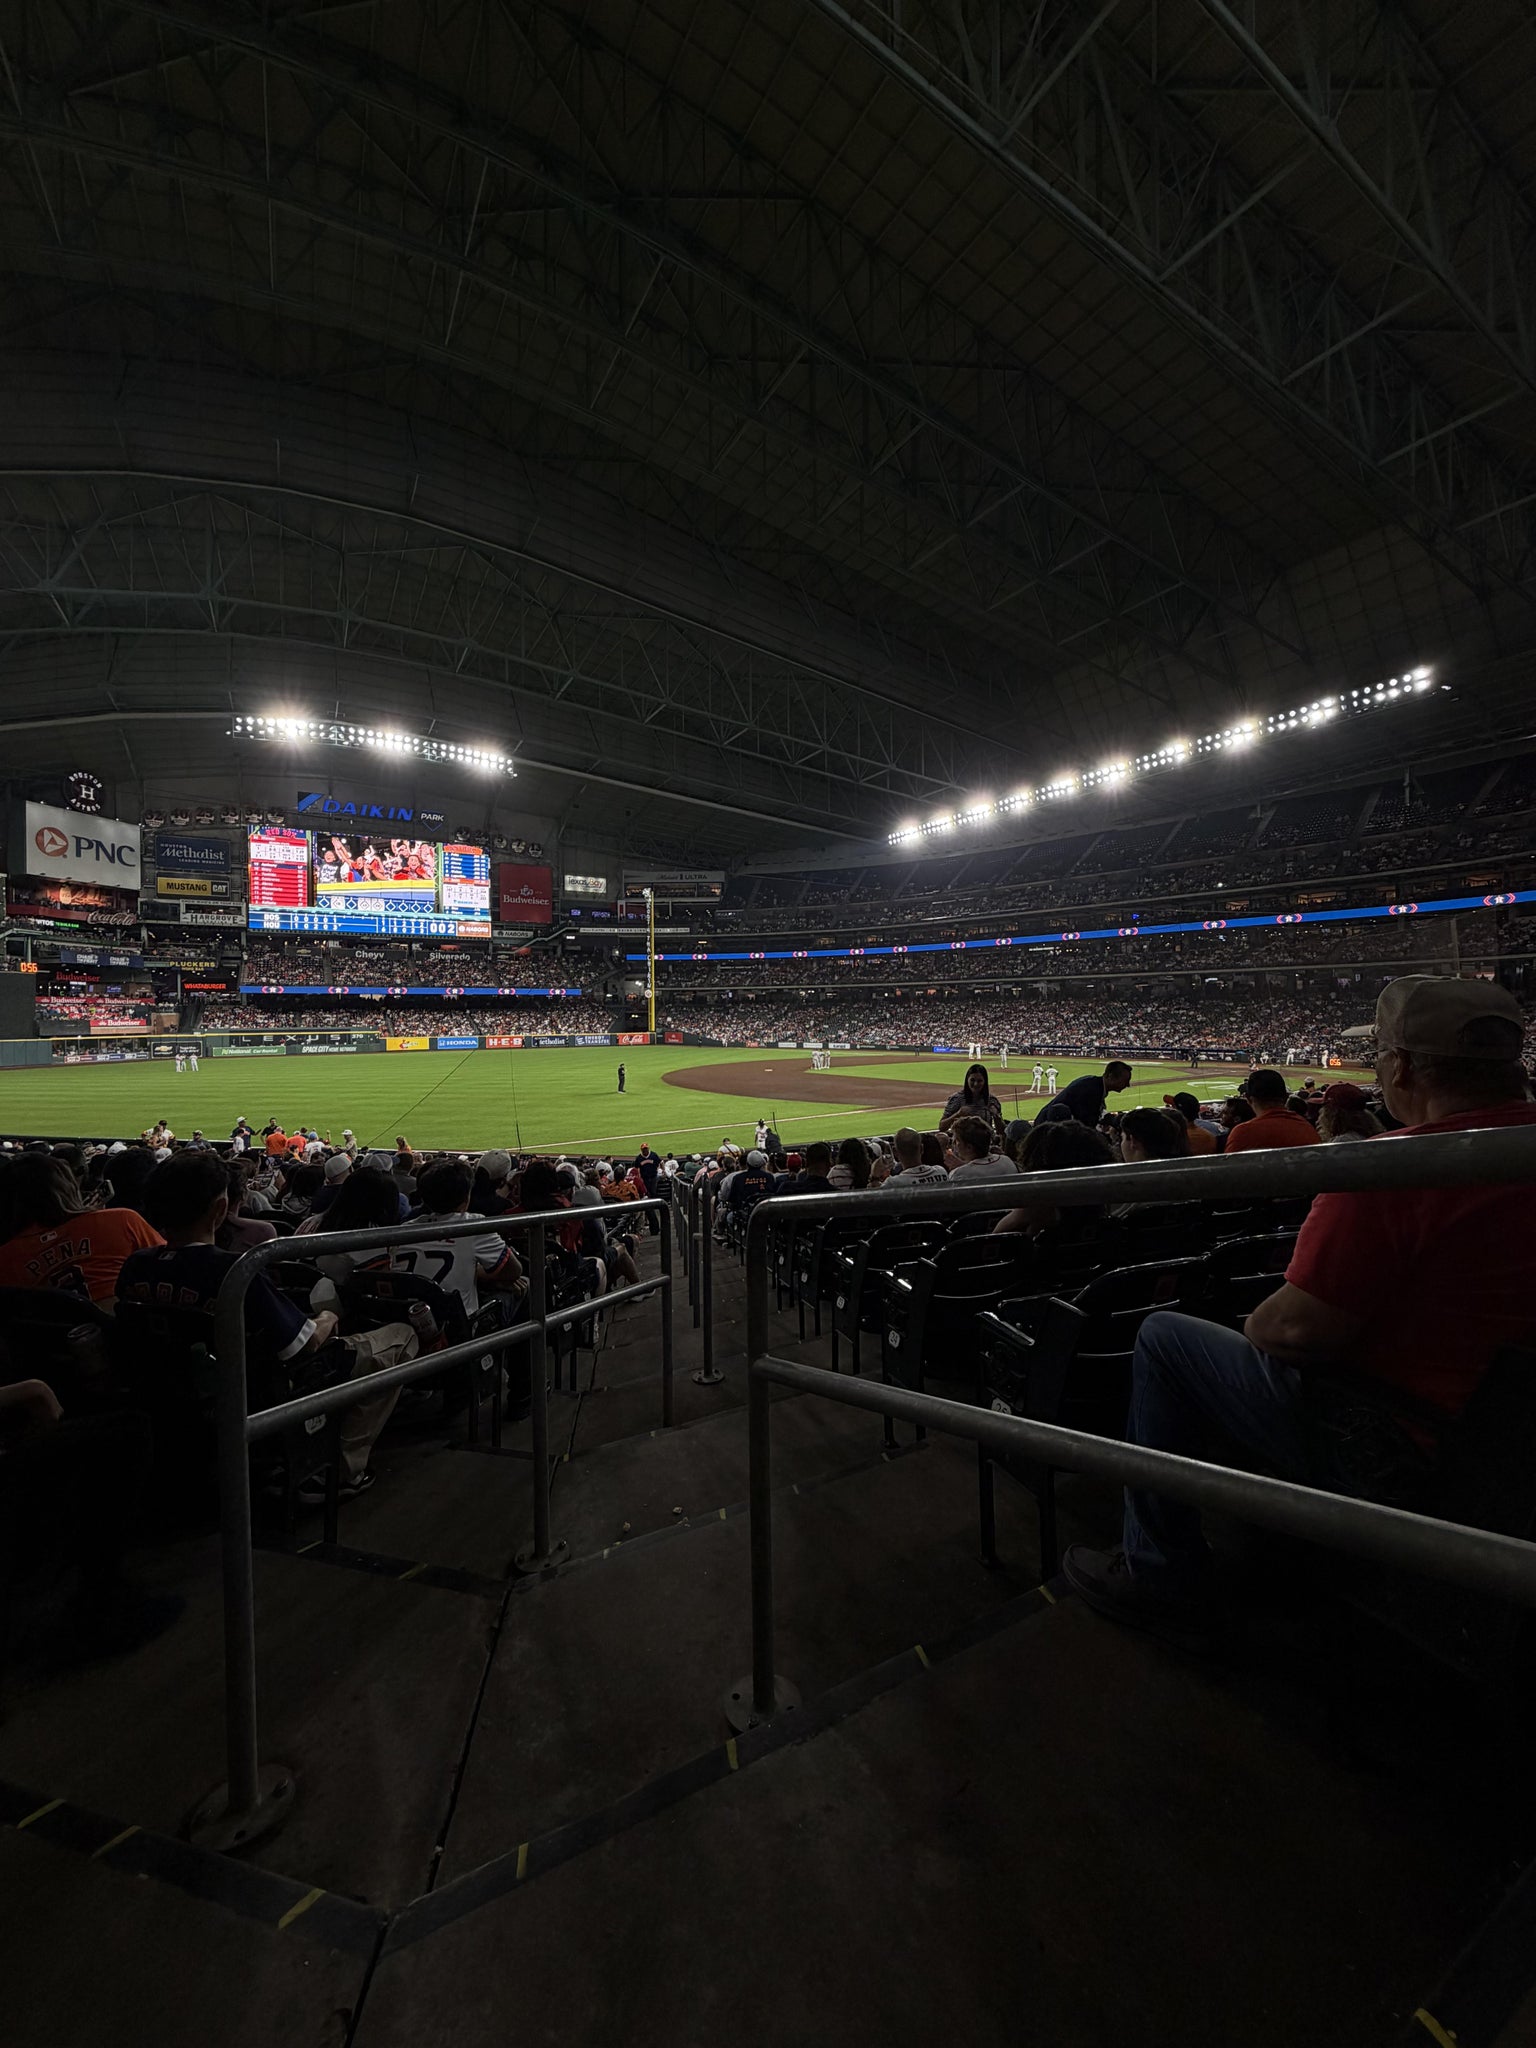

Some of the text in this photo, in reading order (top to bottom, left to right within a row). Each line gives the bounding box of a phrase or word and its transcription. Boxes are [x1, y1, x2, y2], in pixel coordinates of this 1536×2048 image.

[68, 772, 103, 789] HOUSTON
[80, 785, 96, 801] H
[70, 797, 101, 812] ASTROS
[322, 799, 415, 822] DAIKIN
[421, 813, 445, 822] PARK
[71, 835, 136, 868] PNC
[161, 847, 226, 861] Methodist
[166, 882, 227, 893] MUSTANG CAT
[567, 877, 604, 889] Texas Bay
[503, 894, 550, 906] Budweiser
[190, 914, 239, 924] HARGROVE
[264, 913, 281, 921] BOS
[264, 921, 281, 929] HOU
[21, 963, 39, 974] 0:56
[169, 960, 216, 968] PLUCKERS
[56, 971, 101, 983] Budweiser
[184, 983, 227, 991] WHATABURGER
[302, 1046, 318, 1054] SPACE
[318, 1045, 330, 1053] CITY
[395, 1250, 455, 1284] 77
